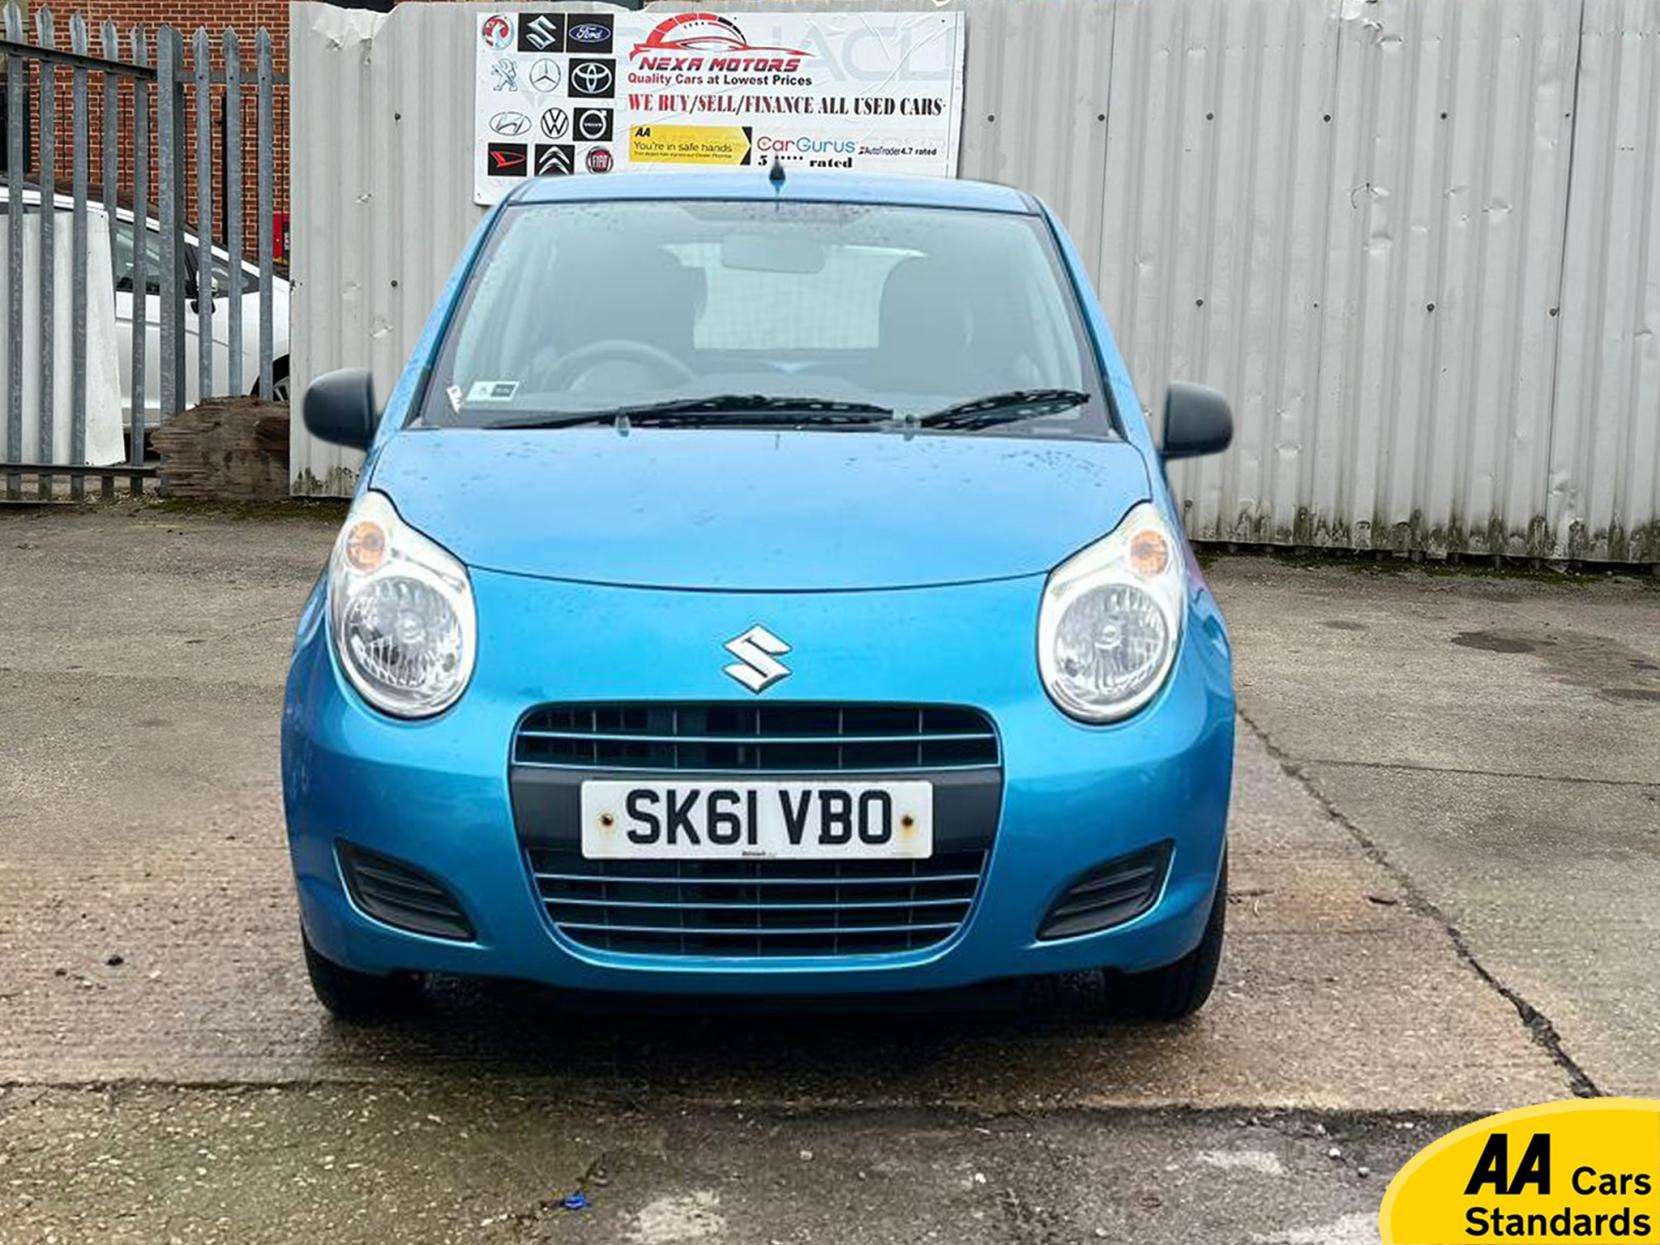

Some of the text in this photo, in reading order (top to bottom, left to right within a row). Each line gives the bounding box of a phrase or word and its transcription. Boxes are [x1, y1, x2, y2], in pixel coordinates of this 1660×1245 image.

[575, 24, 603, 39] Ford
[639, 56, 801, 72] NEXA MOTORS
[628, 73, 812, 86] Quality Cars at Lowest Prices
[628, 94, 942, 116] WE BUY/SELL/FINANCE ALL USED CARS
[635, 127, 651, 137] AA
[634, 141, 732, 153] You're in safe hands
[757, 136, 855, 153] CarGurus
[915, 147, 938, 155] rated
[758, 155, 853, 168] 5 rated
[625, 789, 892, 845] SK61 VBO
